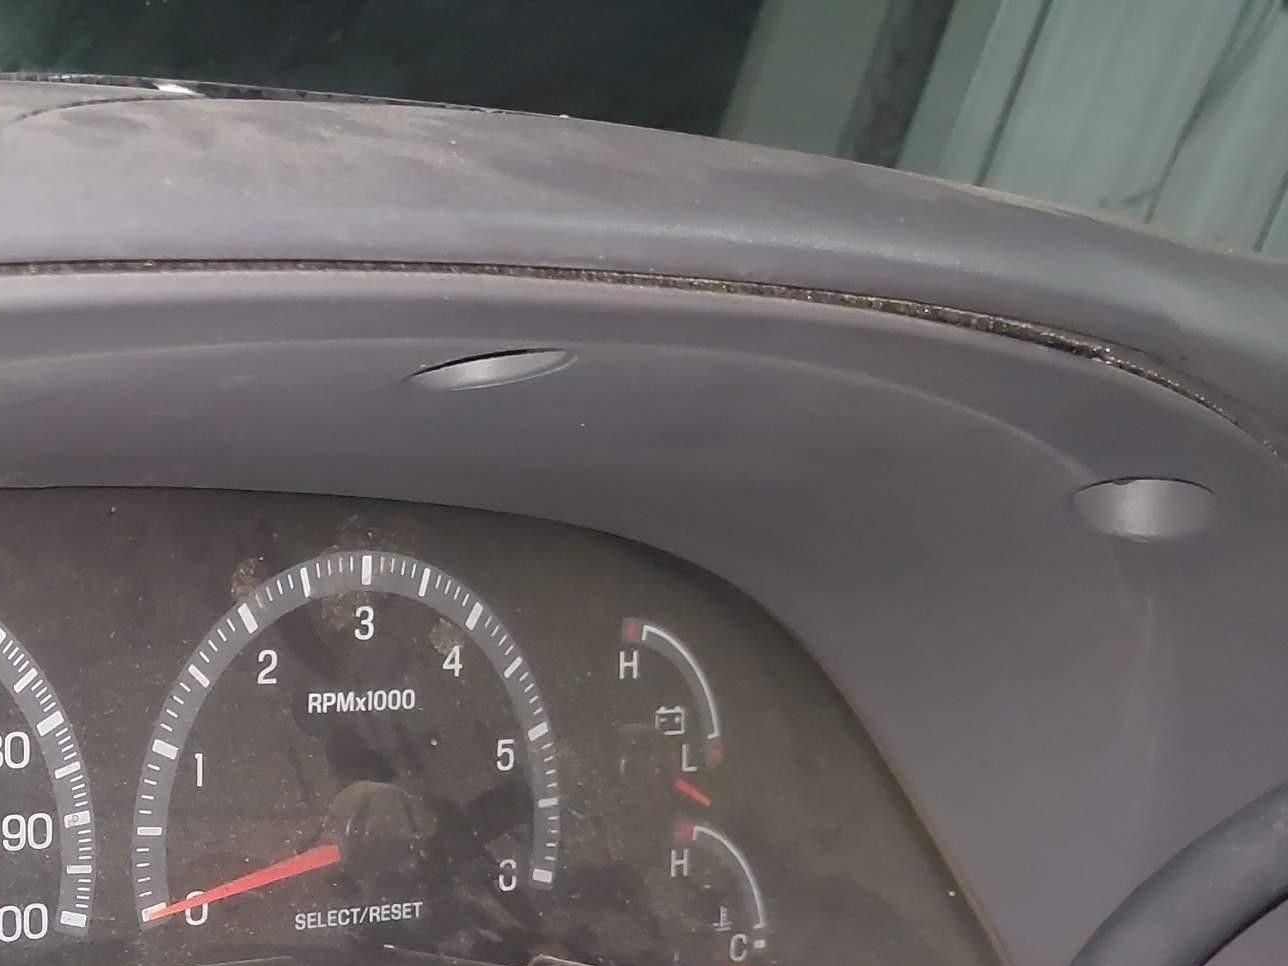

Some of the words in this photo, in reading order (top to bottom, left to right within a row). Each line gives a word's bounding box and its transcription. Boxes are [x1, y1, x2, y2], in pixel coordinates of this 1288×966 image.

[354, 605, 375, 642] 3
[257, 649, 279, 685] 2
[442, 643, 464, 676] 4
[617, 650, 639, 680] H
[307, 689, 416, 715] RPMx1000
[194, 752, 205, 787] 1
[495, 739, 516, 771] 5
[681, 743, 698, 772] L
[0, 811, 54, 853] 90
[669, 849, 689, 877] H
[184, 890, 210, 927] 0
[294, 901, 424, 931] SELECT/RESET
[728, 933, 748, 962] C
